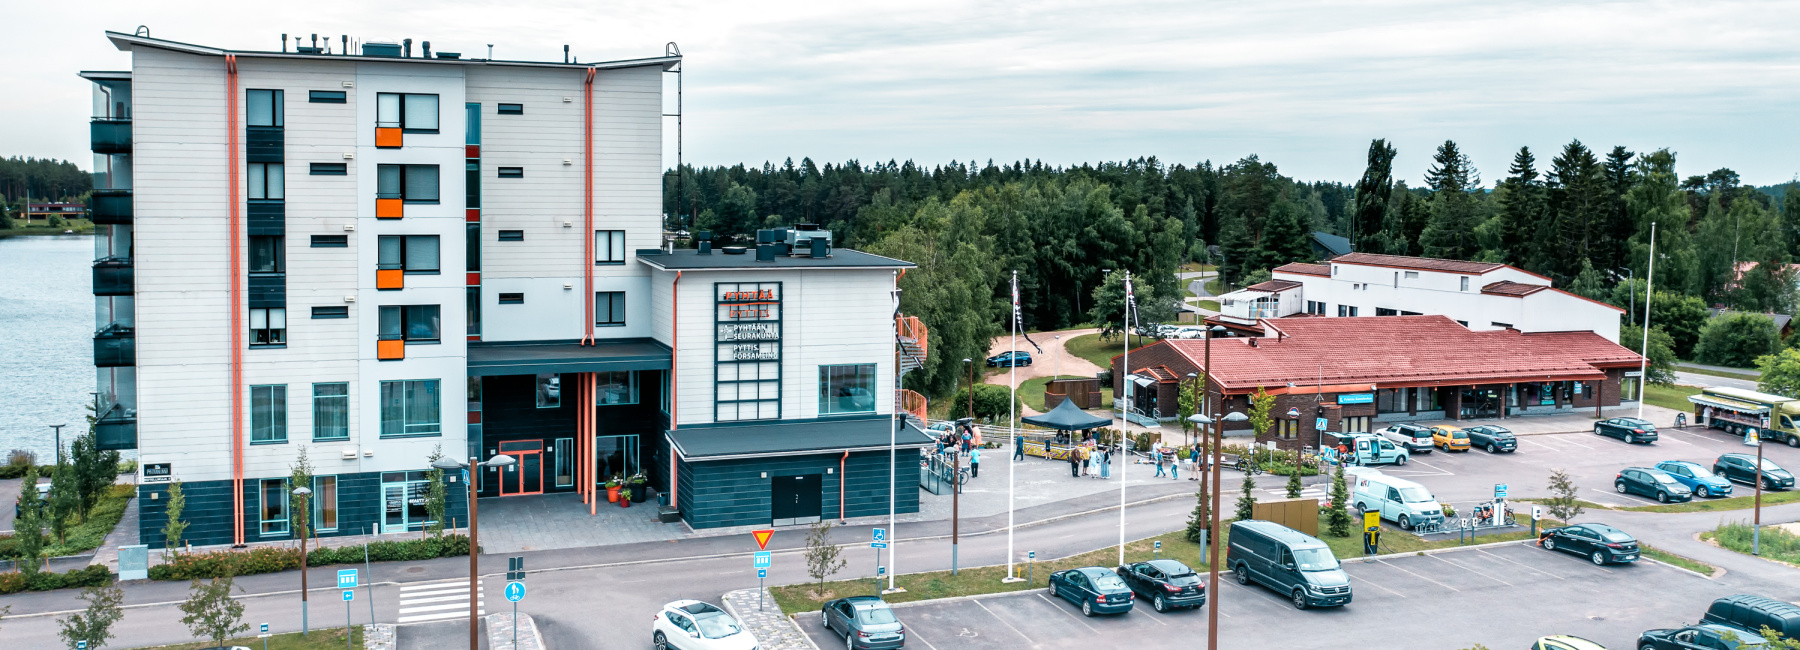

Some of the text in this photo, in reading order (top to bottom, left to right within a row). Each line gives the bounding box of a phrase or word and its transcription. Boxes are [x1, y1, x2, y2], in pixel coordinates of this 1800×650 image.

[725, 289, 774, 300] PYHTÄÄ
[729, 309, 770, 318] PYTTIS
[733, 323, 766, 331] PYHTÄÄN
[733, 332, 779, 340] SEURAKUNTA
